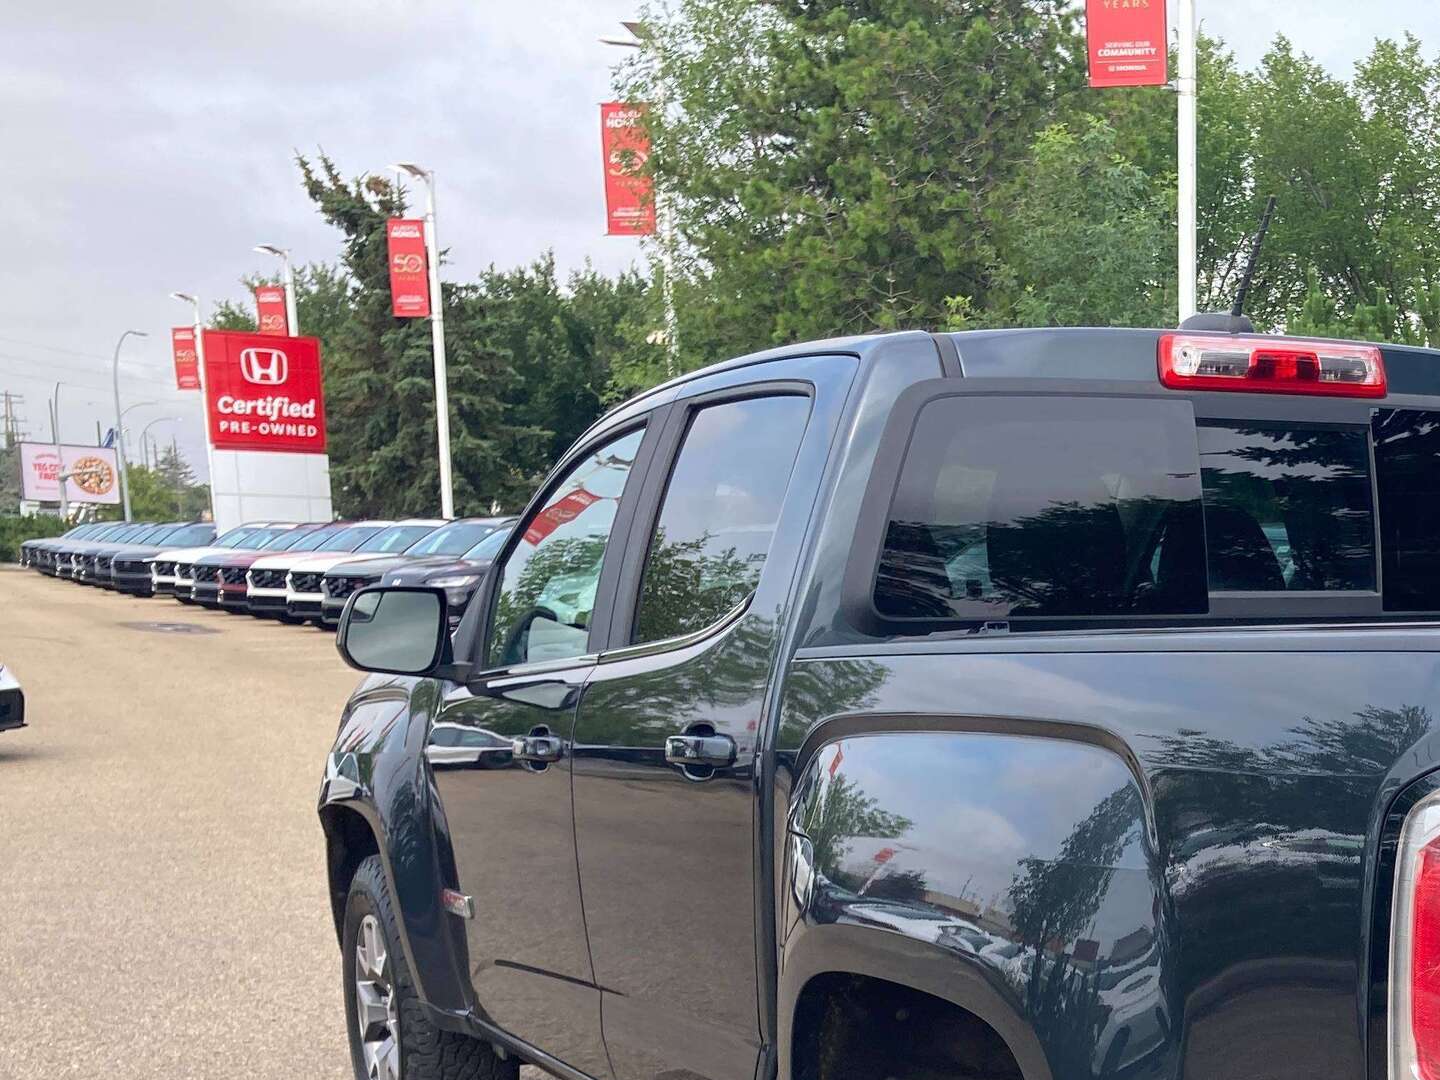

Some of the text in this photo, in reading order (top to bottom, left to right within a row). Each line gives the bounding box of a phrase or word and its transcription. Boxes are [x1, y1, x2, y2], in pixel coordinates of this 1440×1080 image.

[1098, 47, 1157, 57] COMMUNITY
[217, 395, 316, 422] Certified
[219, 421, 317, 438] PRE-OWNED
